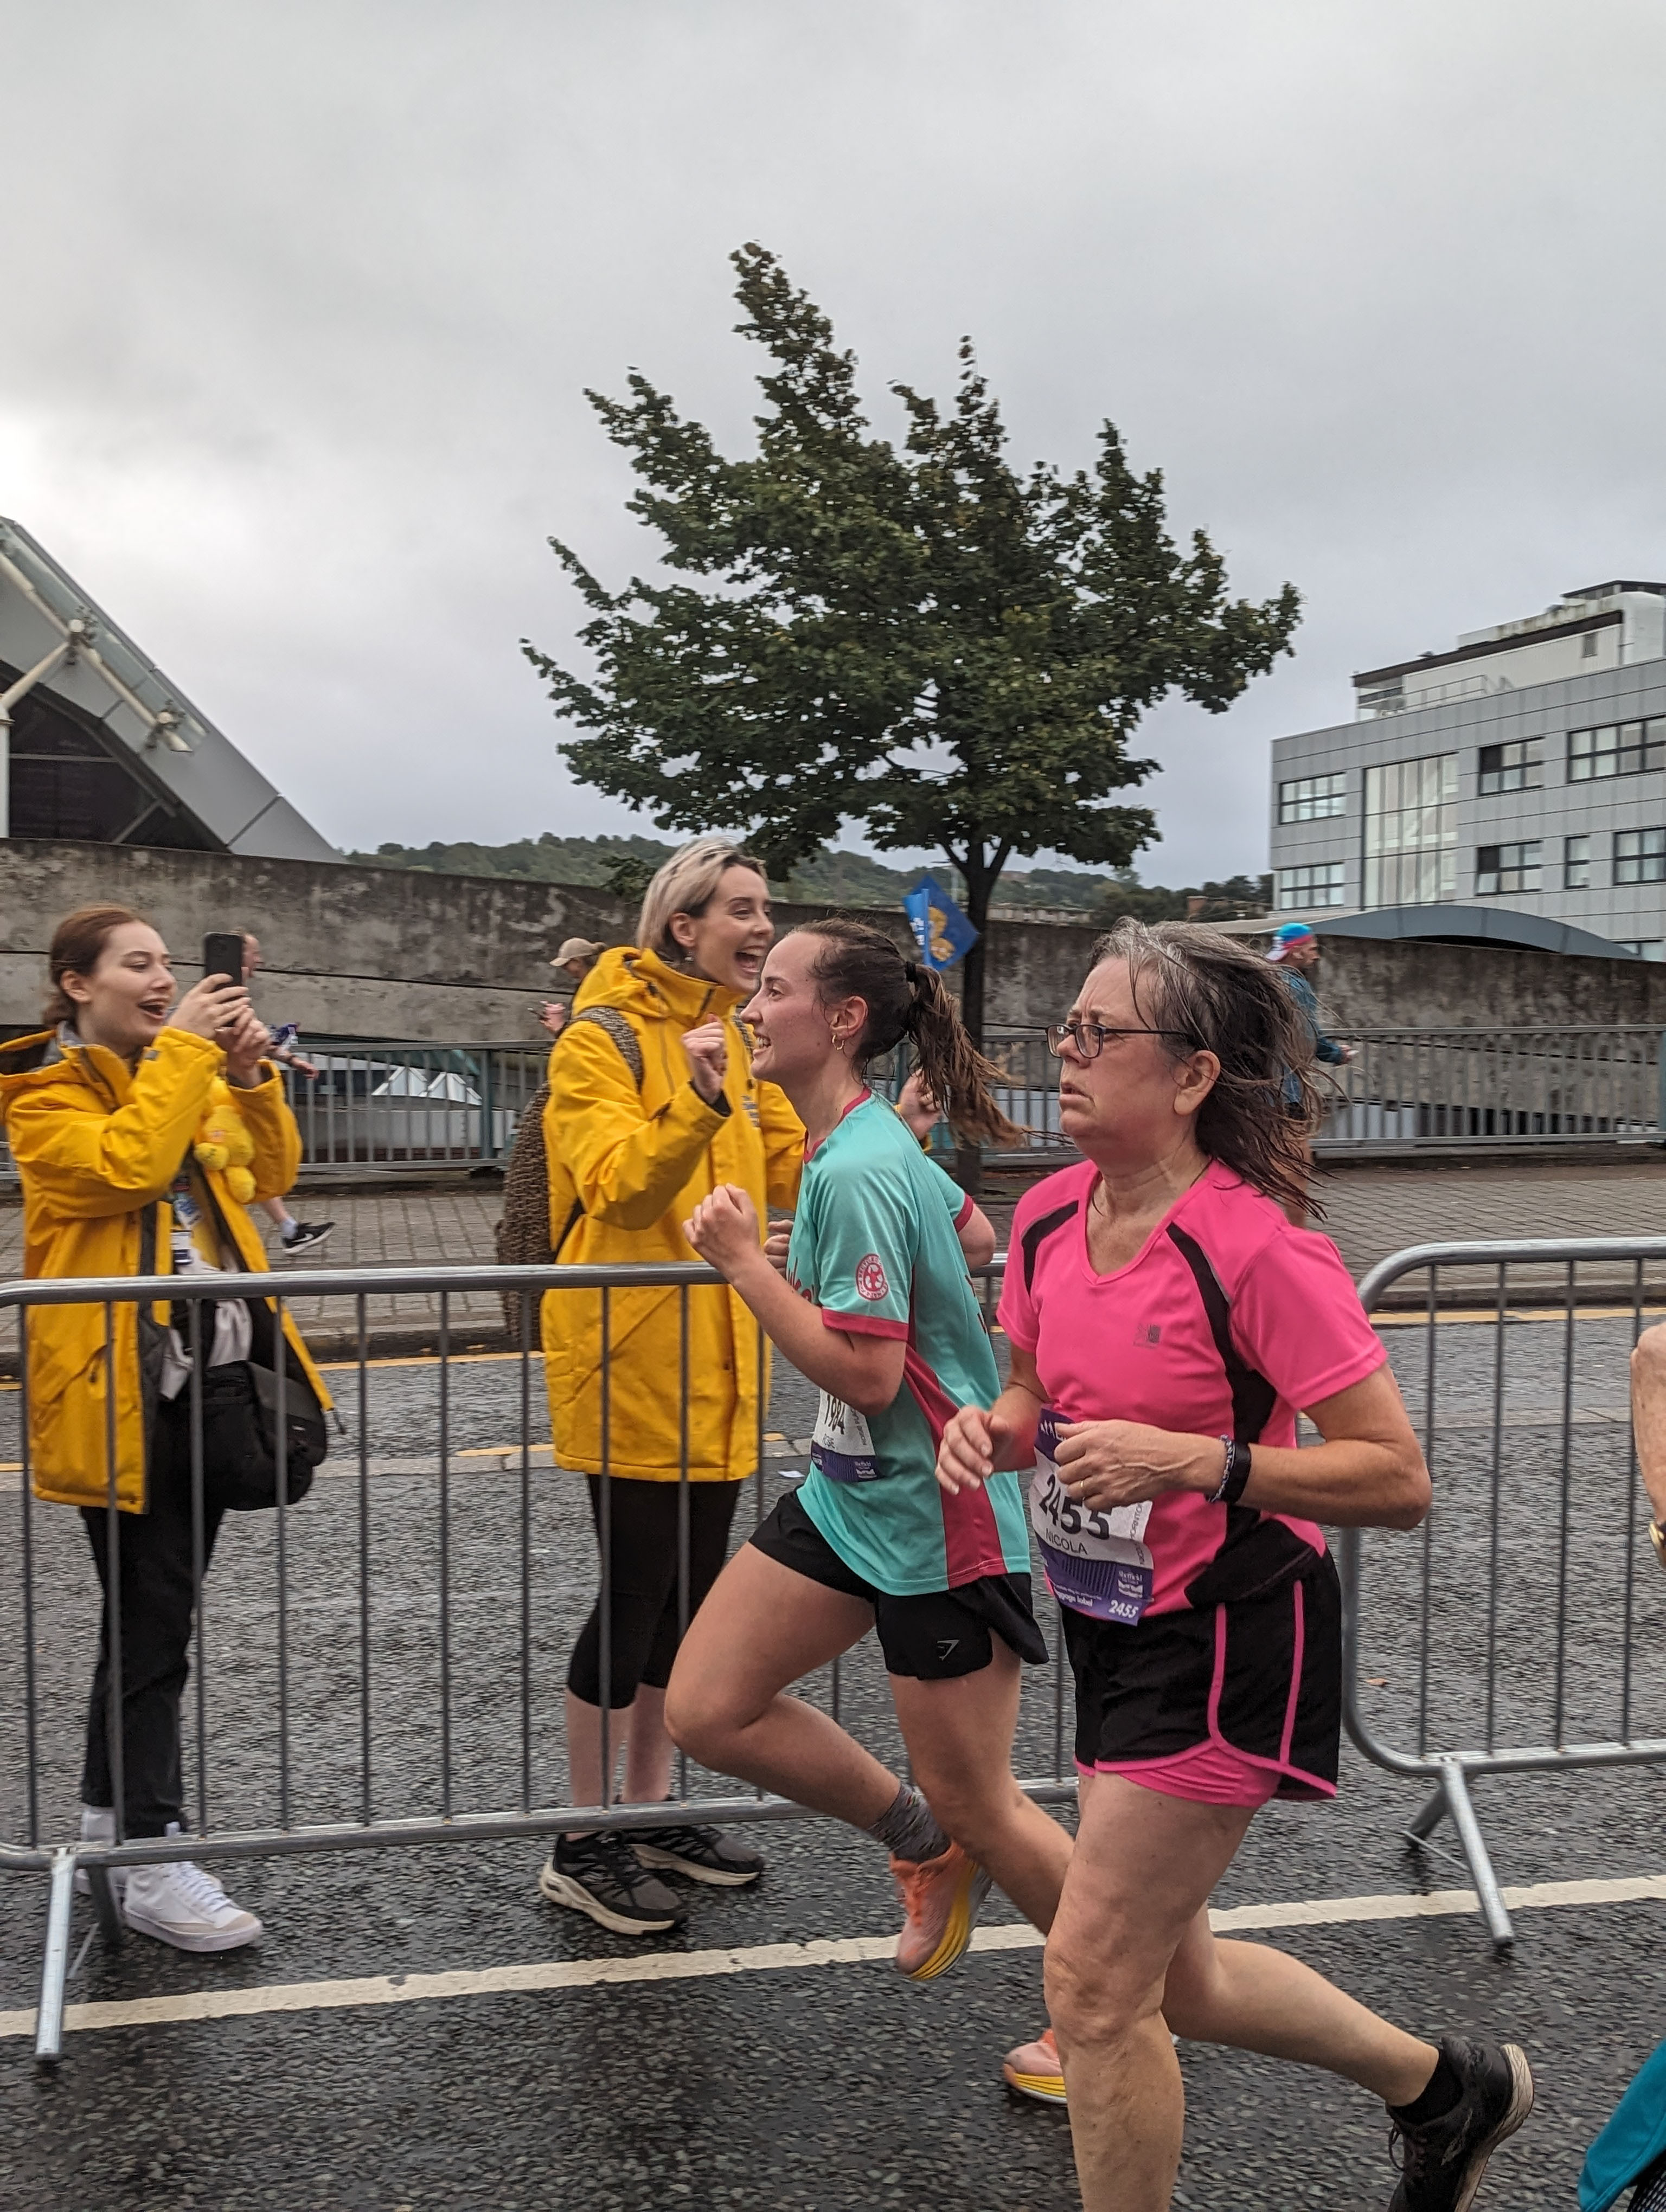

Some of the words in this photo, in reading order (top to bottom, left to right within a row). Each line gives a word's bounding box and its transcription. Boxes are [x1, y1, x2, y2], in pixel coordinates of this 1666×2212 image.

[824, 1394, 845, 1436] 1984
[1039, 1474, 1112, 1540] 2455
[1046, 1528, 1088, 1555] NICOLA
[1108, 1599, 1139, 1618] 2455
